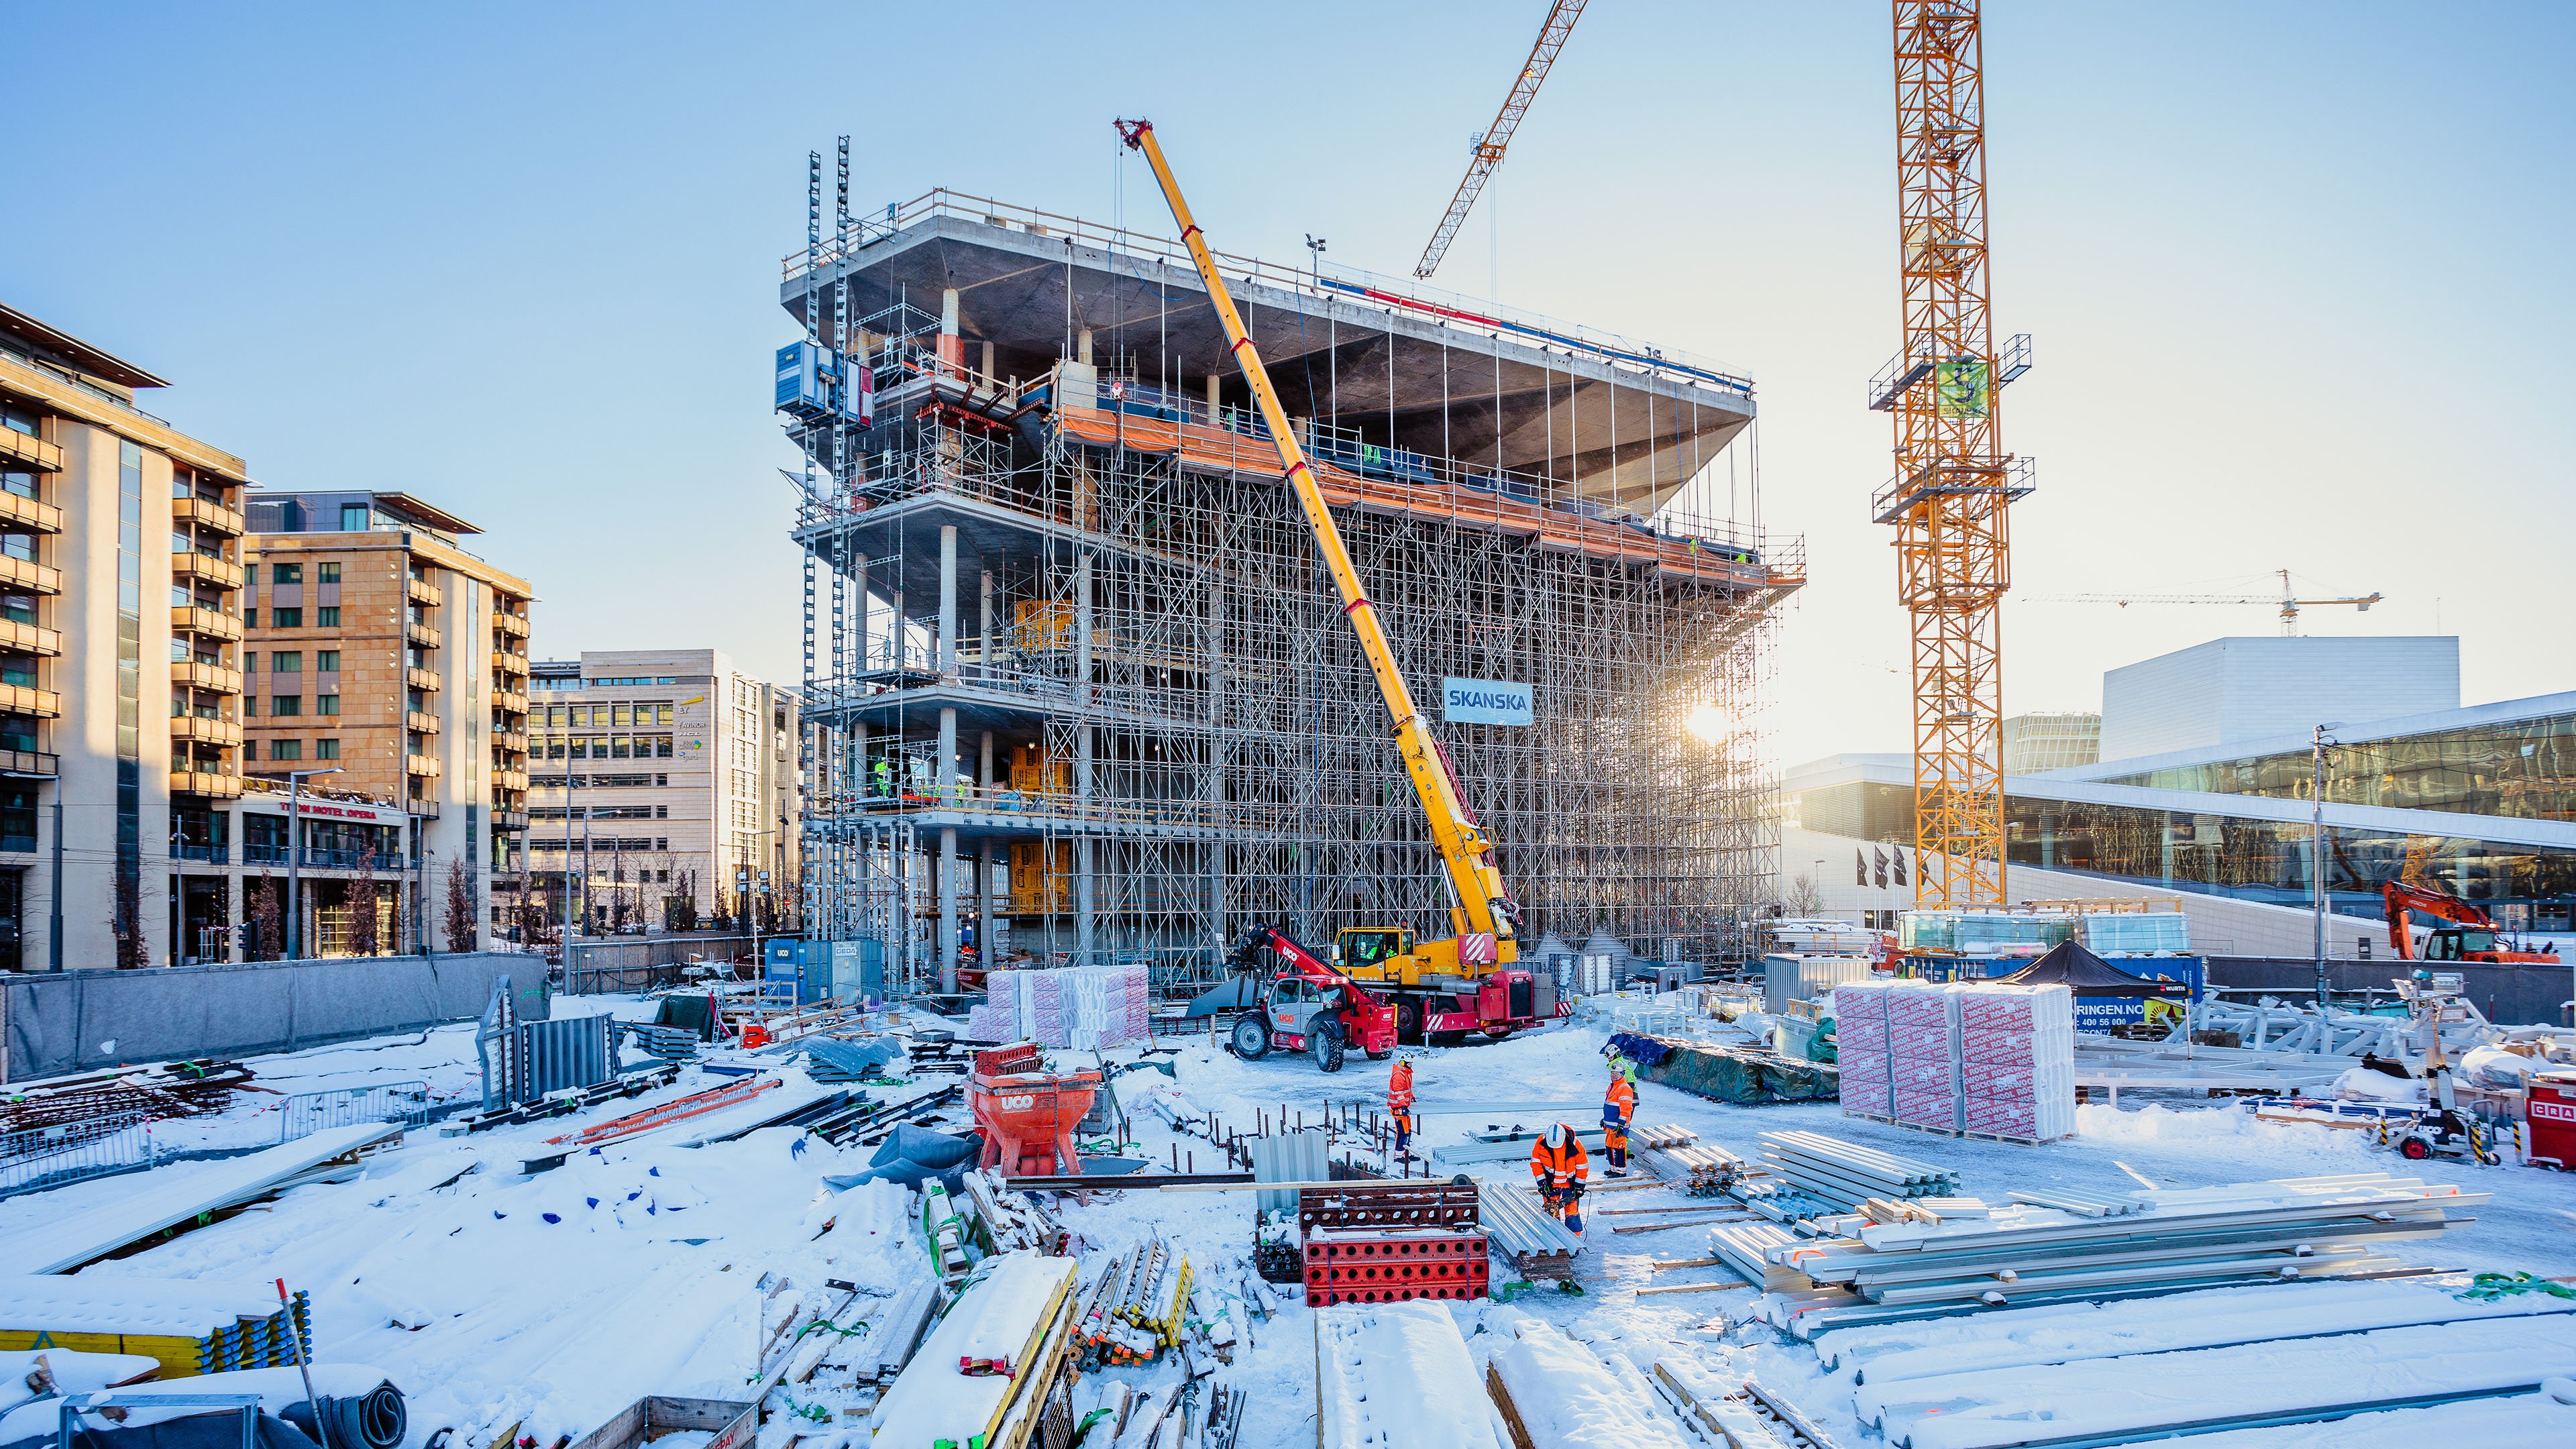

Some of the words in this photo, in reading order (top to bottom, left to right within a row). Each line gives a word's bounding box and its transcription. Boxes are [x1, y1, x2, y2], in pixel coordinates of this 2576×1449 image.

[1955, 368, 1974, 402] 5
[1450, 690, 1527, 711] SKANSKA
[313, 806, 344, 816] HOTEL
[347, 809, 376, 819] OPERA
[1283, 946, 1297, 961] UCO
[2072, 1005, 2144, 1016] RINGEN.NO
[1279, 1014, 1295, 1024] UCO
[2082, 1018, 2096, 1026] 400
[2099, 1018, 2109, 1026] 56
[1968, 1030, 2012, 1046] ROCKWOOL
[1970, 1046, 2012, 1062] ROCKWOOL
[1002, 1095, 1034, 1110] UCO
[2535, 1106, 2572, 1118] CRA
[2418, 1125, 2443, 1135] UCO
[711, 1430, 735, 1449] EPAY
